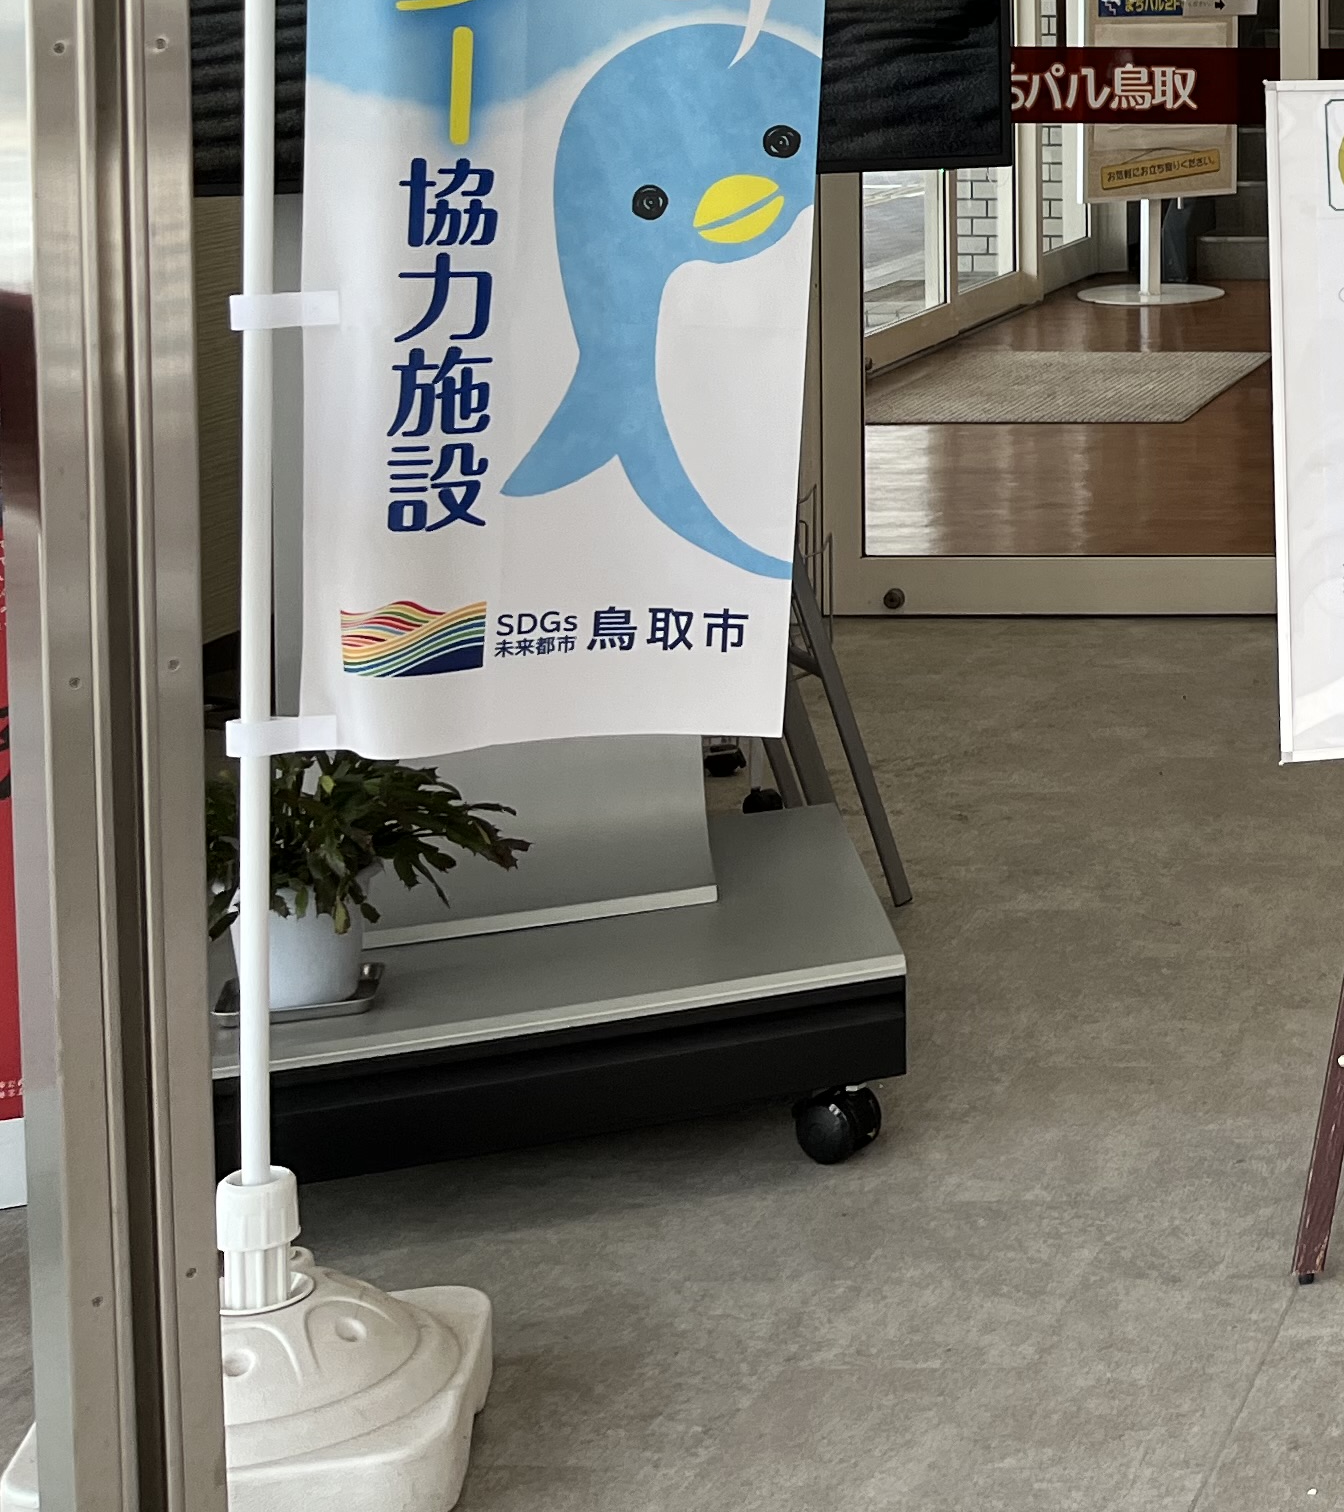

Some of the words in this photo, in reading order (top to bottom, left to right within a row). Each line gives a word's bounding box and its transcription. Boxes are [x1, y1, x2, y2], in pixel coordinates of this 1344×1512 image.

[386, 157, 498, 533] 協力施設
[496, 610, 579, 637] SDGs
[586, 605, 750, 653] 鳥取市
[493, 635, 577, 658] 未来都市
